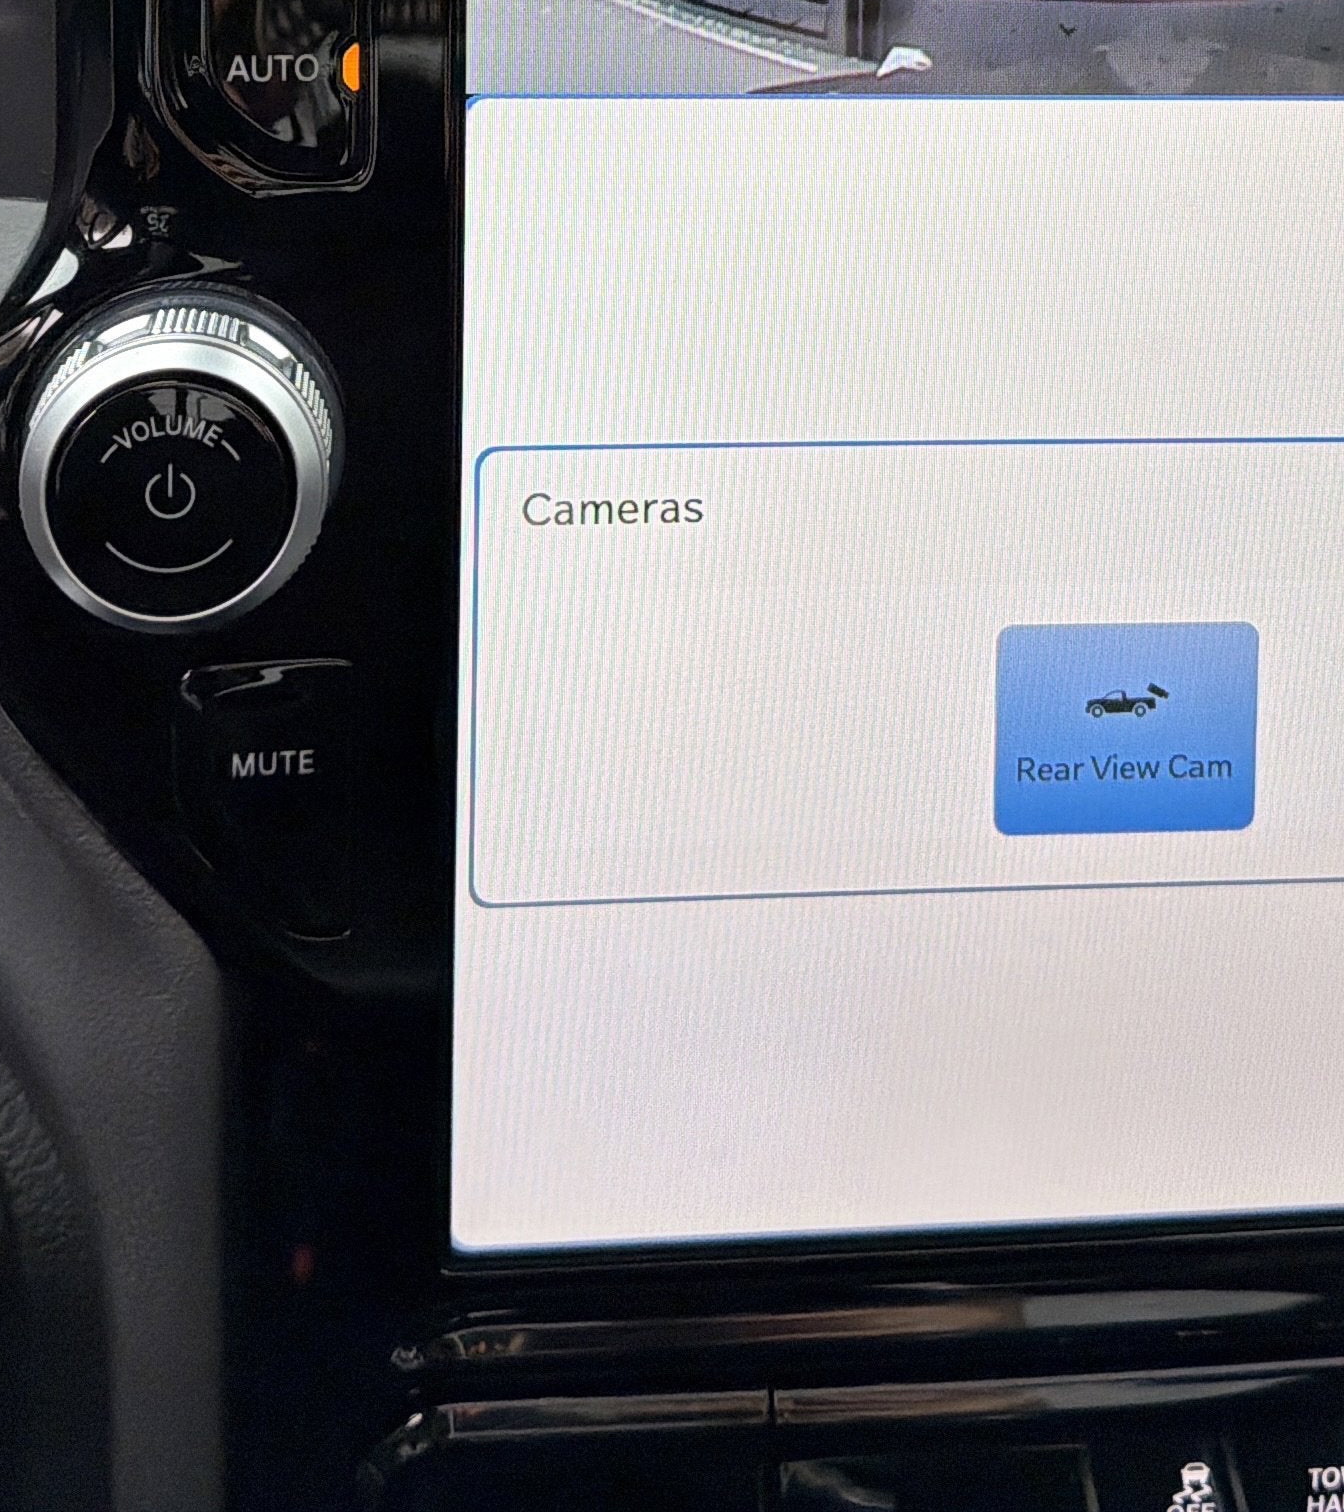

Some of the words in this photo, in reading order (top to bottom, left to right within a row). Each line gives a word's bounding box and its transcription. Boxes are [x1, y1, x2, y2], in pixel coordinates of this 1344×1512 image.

[226, 53, 320, 83] AUTO
[111, 412, 224, 451] VOLUME
[522, 492, 704, 526] Cameras
[231, 749, 314, 778] MUTE
[1017, 756, 1085, 783] Rear
[1090, 753, 1161, 781] View
[1168, 754, 1233, 779] Cam
